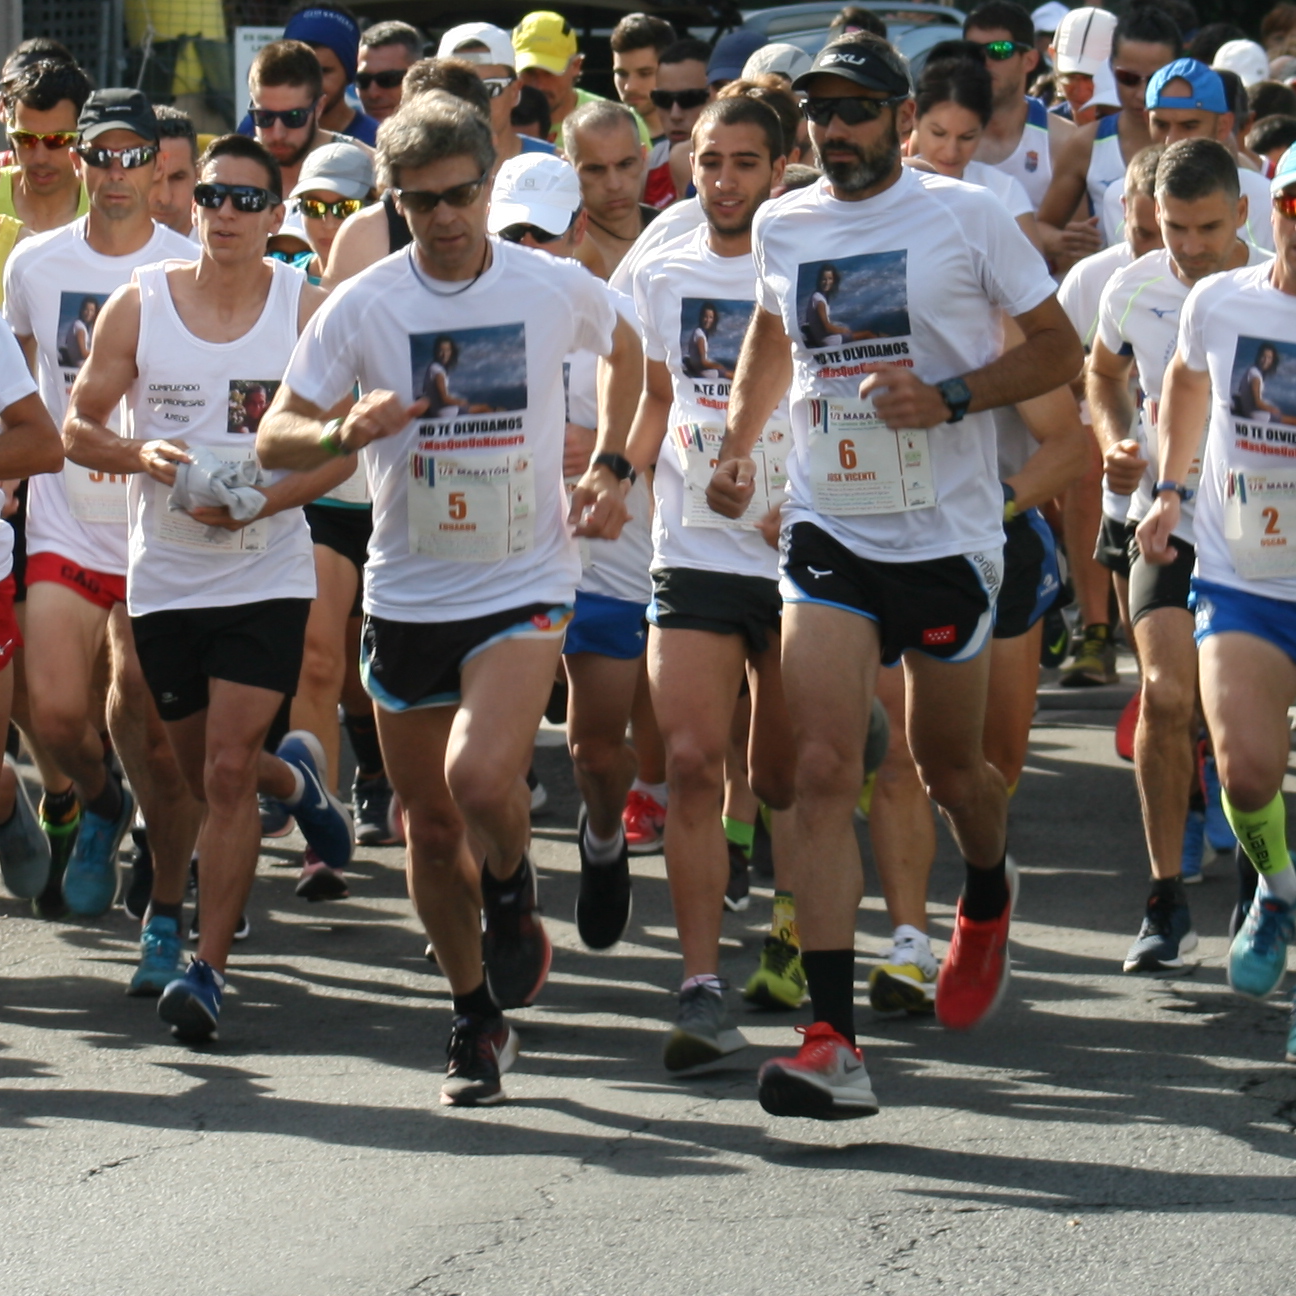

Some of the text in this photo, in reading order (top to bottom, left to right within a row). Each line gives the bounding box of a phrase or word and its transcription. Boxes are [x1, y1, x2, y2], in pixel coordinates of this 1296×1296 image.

[828, 351, 842, 363] TE
[842, 341, 909, 362] OLVIDAMOS
[419, 416, 523, 437] NO TE OLVIDAMOS
[844, 412, 877, 420] MARAT
[1235, 422, 1248, 436] NO
[1251, 425, 1263, 438] TE
[838, 439, 858, 470] 6
[827, 471, 877, 482] JOSE VICENTE
[448, 492, 467, 520] 5
[1261, 506, 1281, 535] 2
